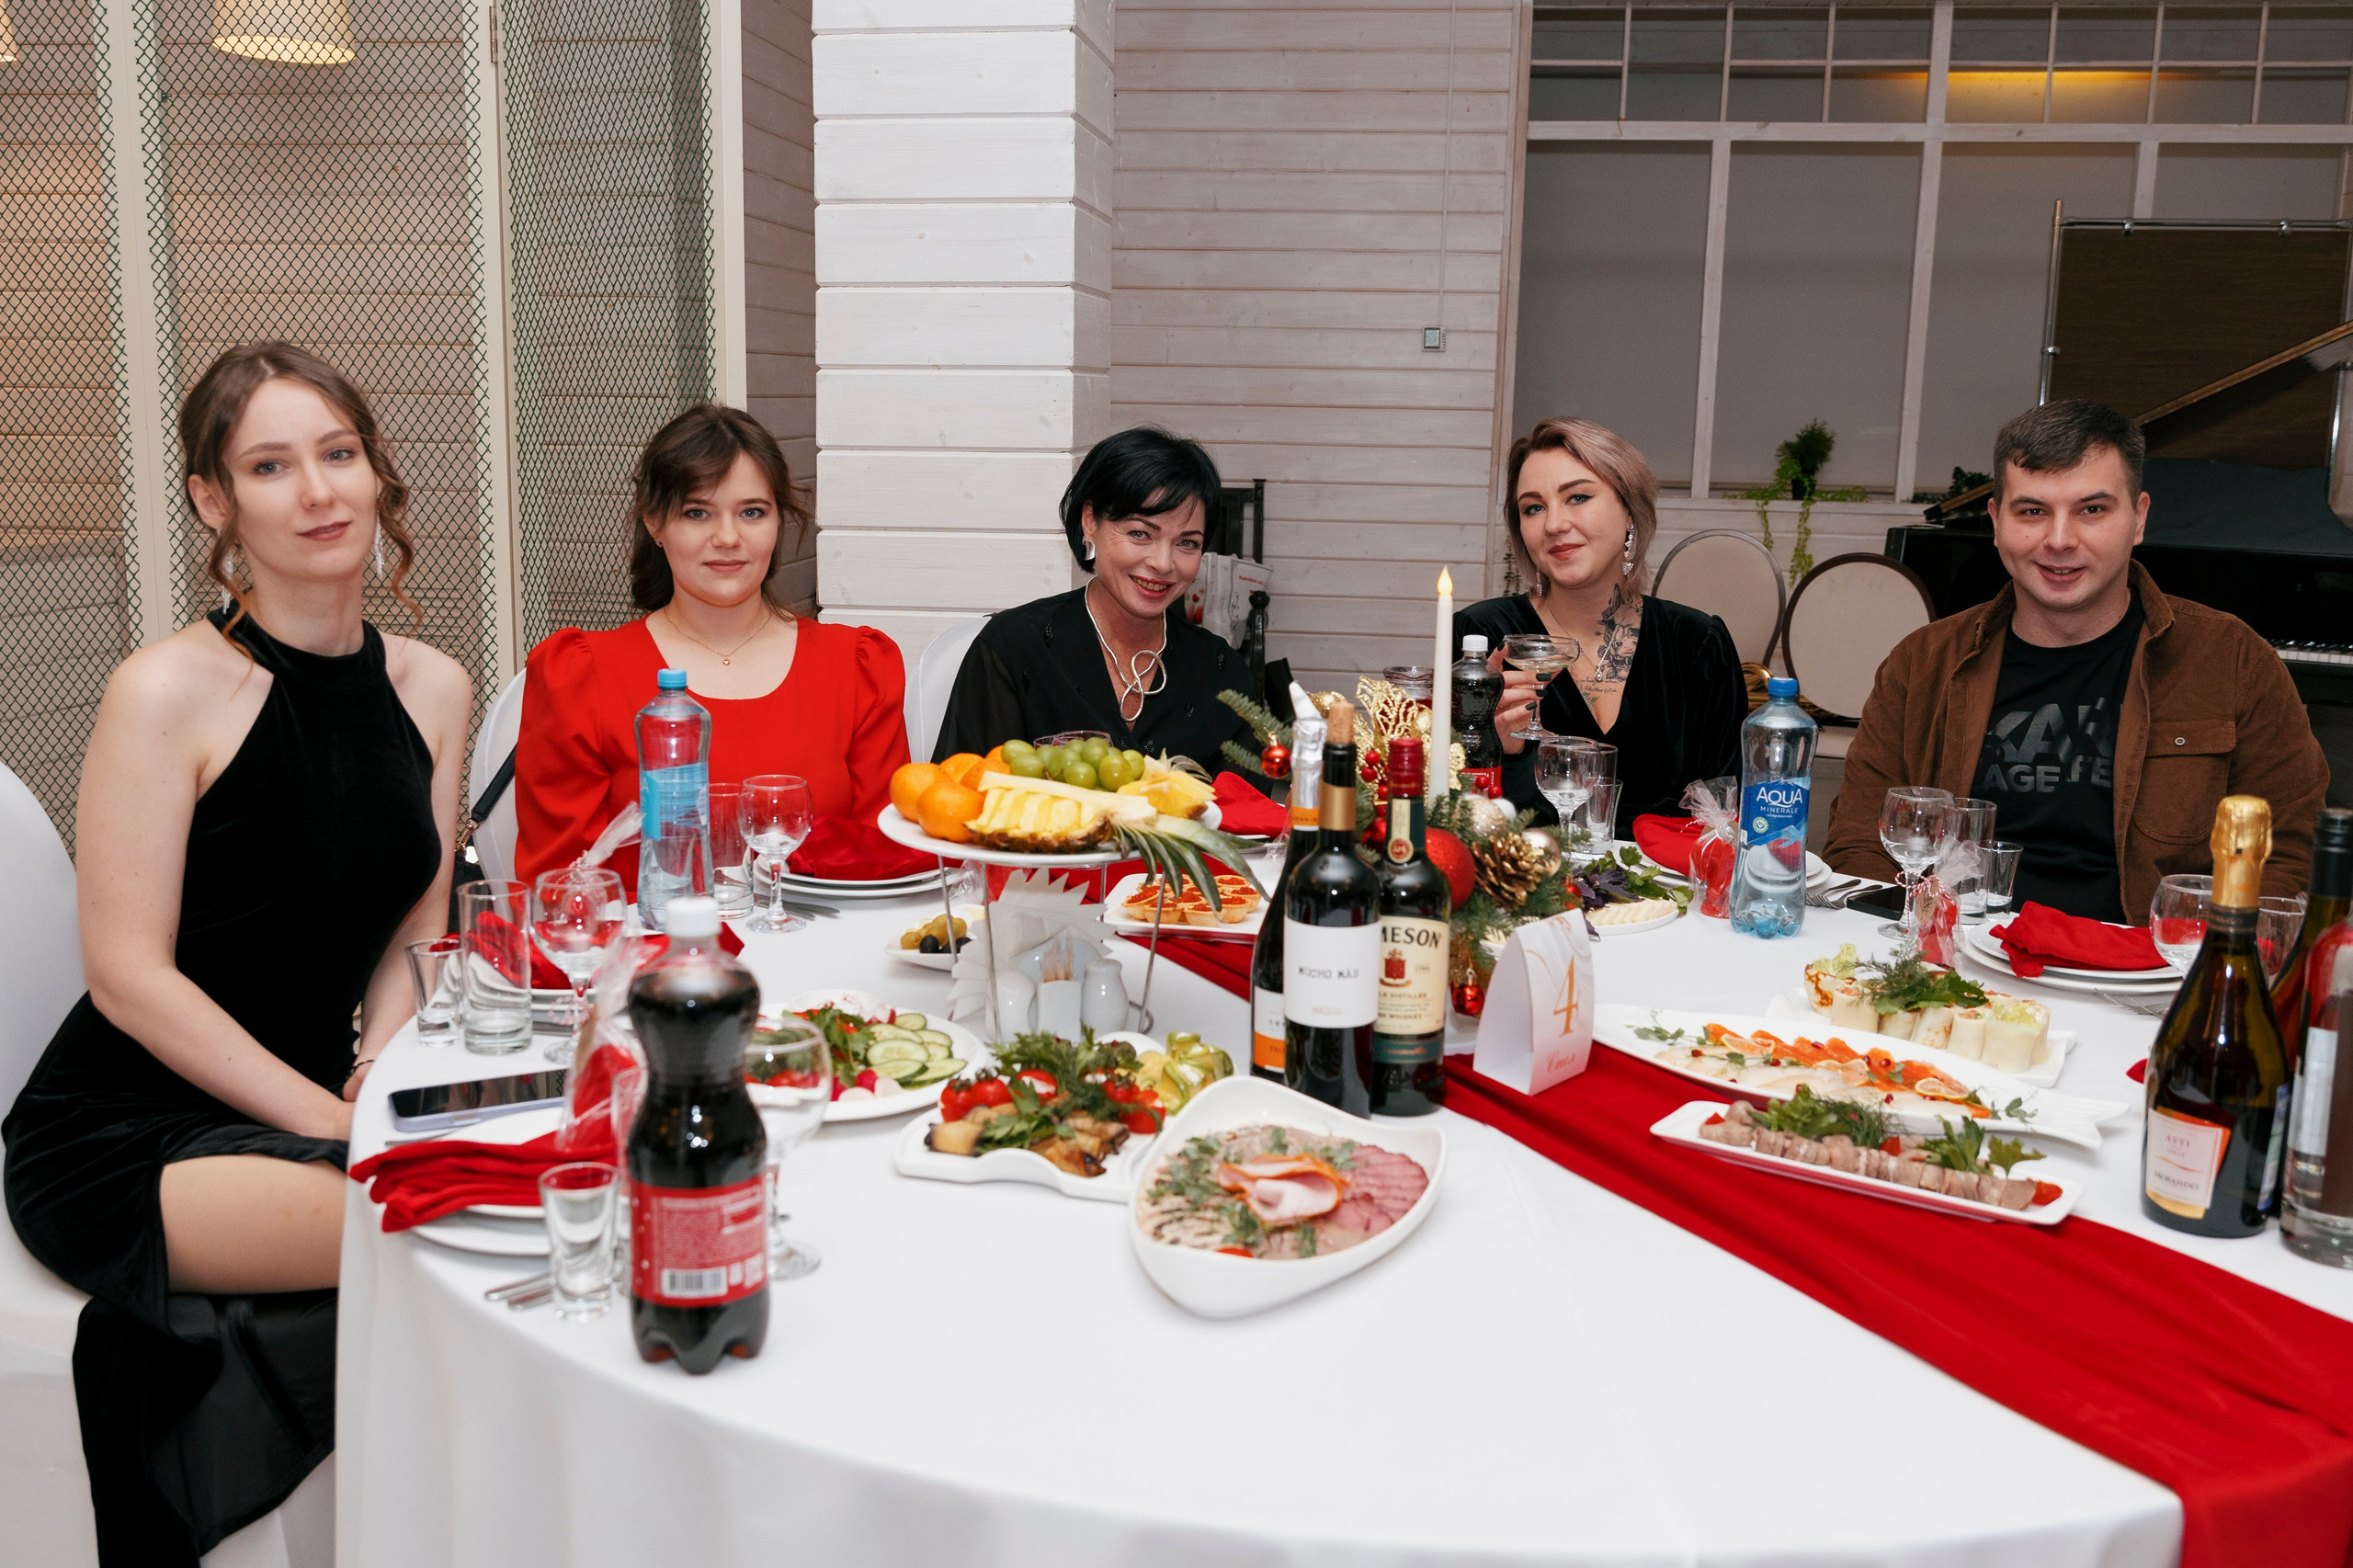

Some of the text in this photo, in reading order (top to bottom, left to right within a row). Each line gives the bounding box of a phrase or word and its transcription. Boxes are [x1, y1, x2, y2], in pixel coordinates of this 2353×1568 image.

[1756, 786, 1803, 808] AQUA
[1759, 806, 1799, 814] MINERALE
[1298, 965, 1332, 979] MUCHO
[1553, 955, 1581, 1038] 4
[2165, 1134, 2191, 1148] ASTI
[2154, 1170, 2200, 1190] MORANDO
